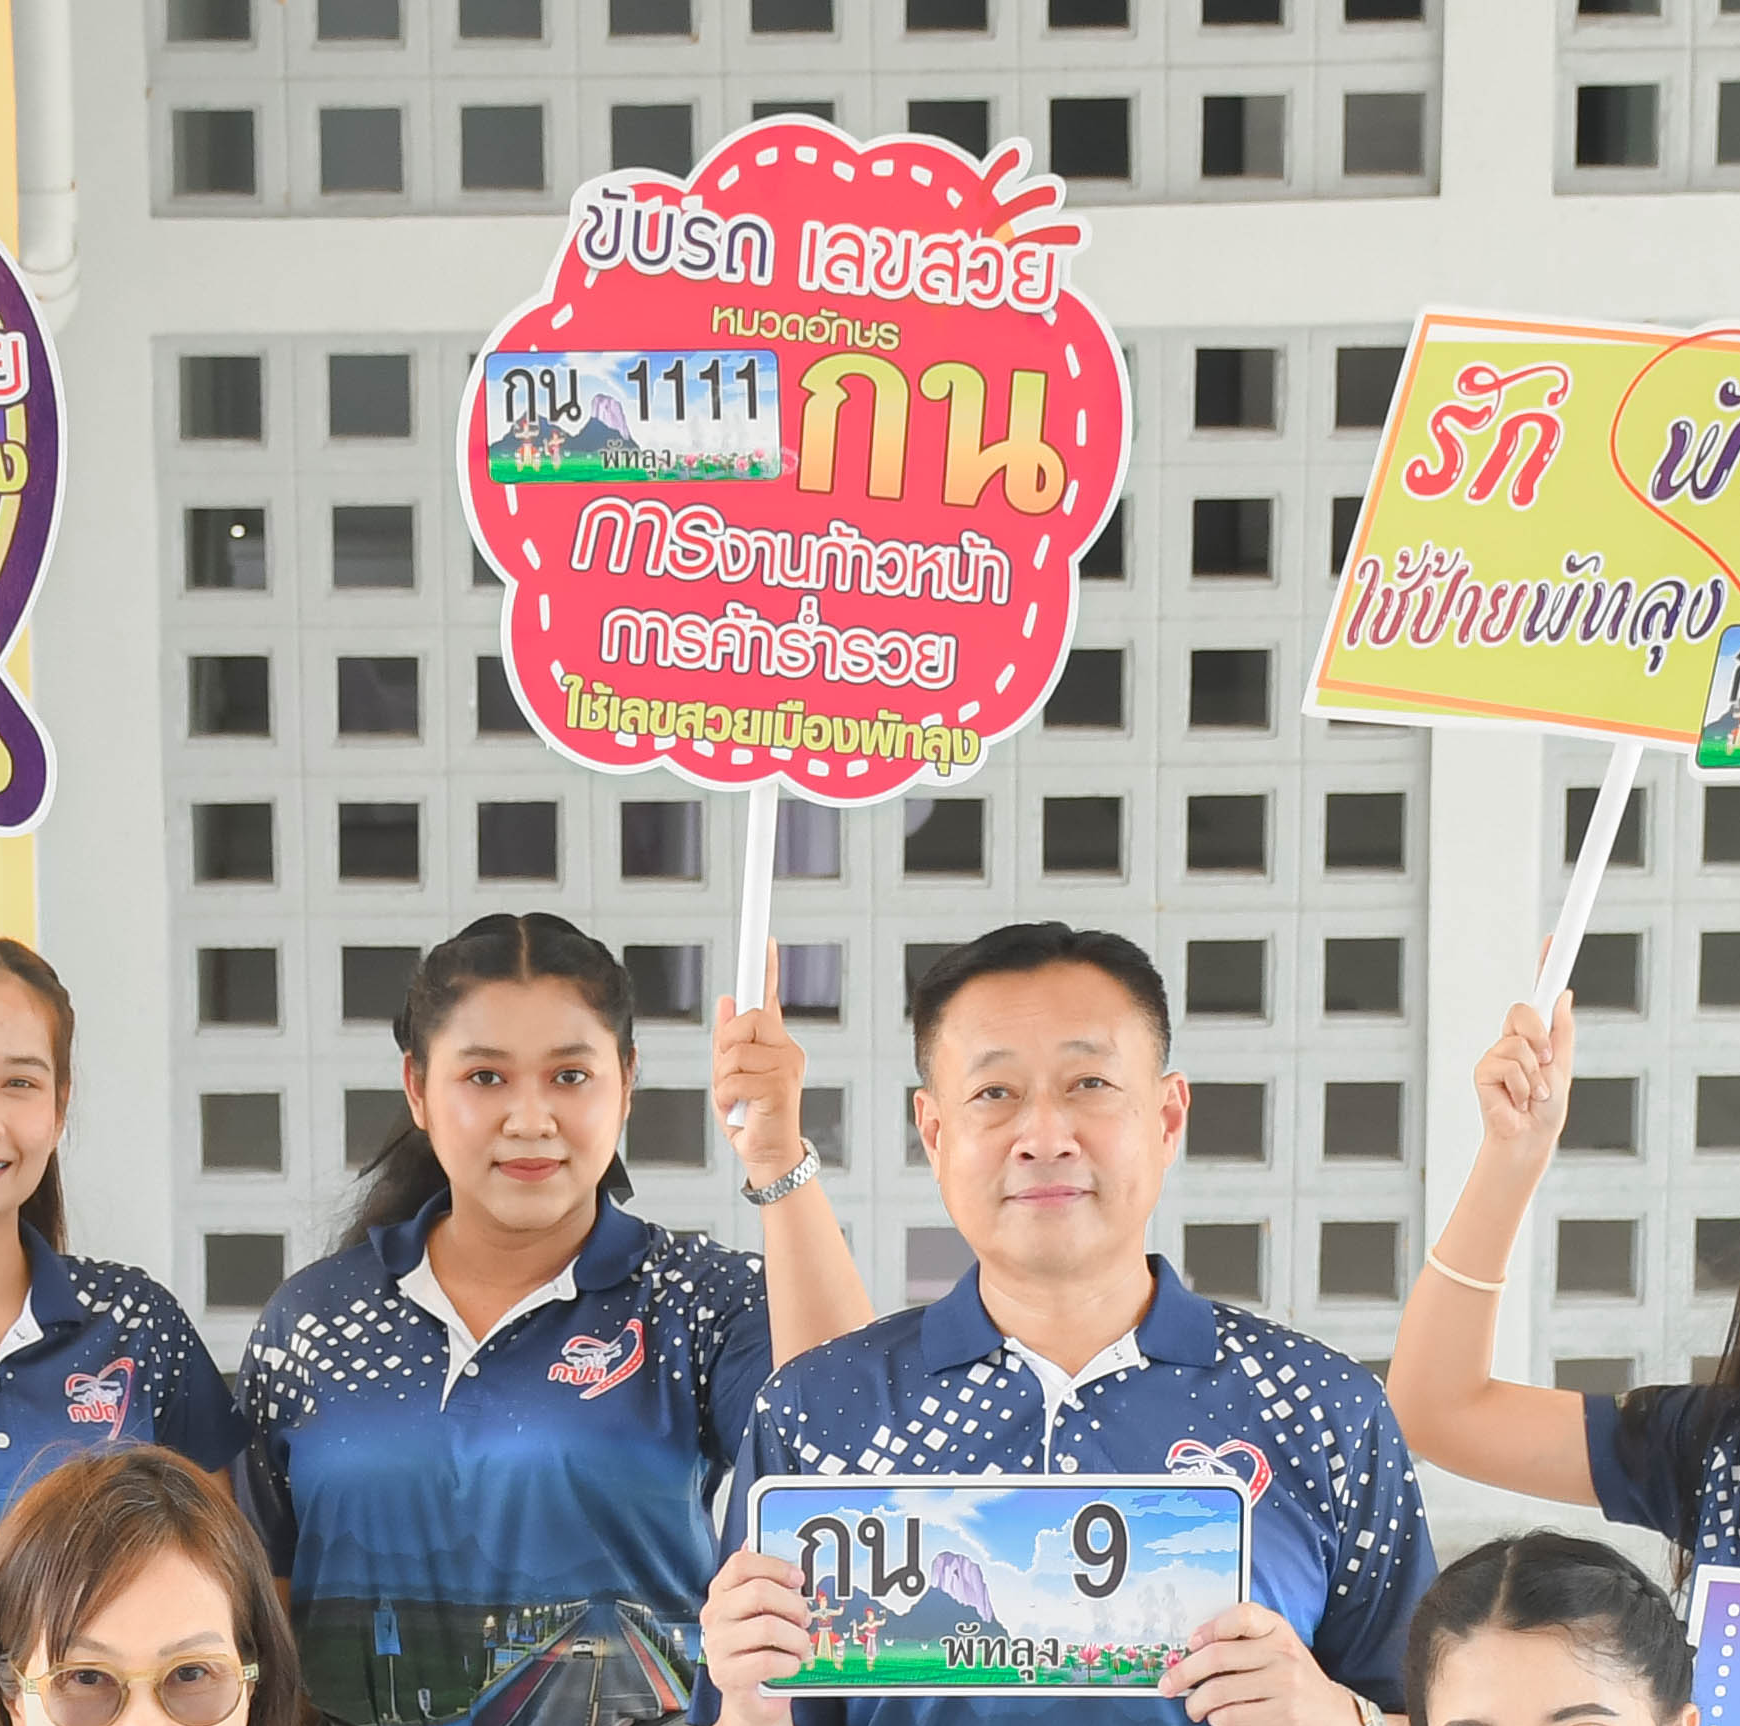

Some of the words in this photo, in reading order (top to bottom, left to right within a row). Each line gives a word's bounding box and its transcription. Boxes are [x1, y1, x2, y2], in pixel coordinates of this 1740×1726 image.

[582, 190, 769, 279] ขับรถ
[805, 224, 1057, 308] เลขสวย
[711, 305, 900, 351] หมวดอักษร
[502, 366, 581, 423] กน
[627, 359, 760, 423] 1111
[799, 353, 1066, 515] กน
[1403, 364, 1570, 507] รัก
[600, 440, 675, 479] พัทลุง
[575, 500, 1009, 602] การงานก้าวหน้า
[604, 599, 954, 688] การค้าร่ำรวย
[1346, 541, 1726, 674] ใช้ป้ายพัทลุง
[562, 676, 981, 775] ใช้เลขสวยเมืองพัทลุง
[797, 1515, 926, 1599] กน
[1072, 1502, 1129, 1599] 9
[941, 1622, 1060, 1682] พัทลุง
